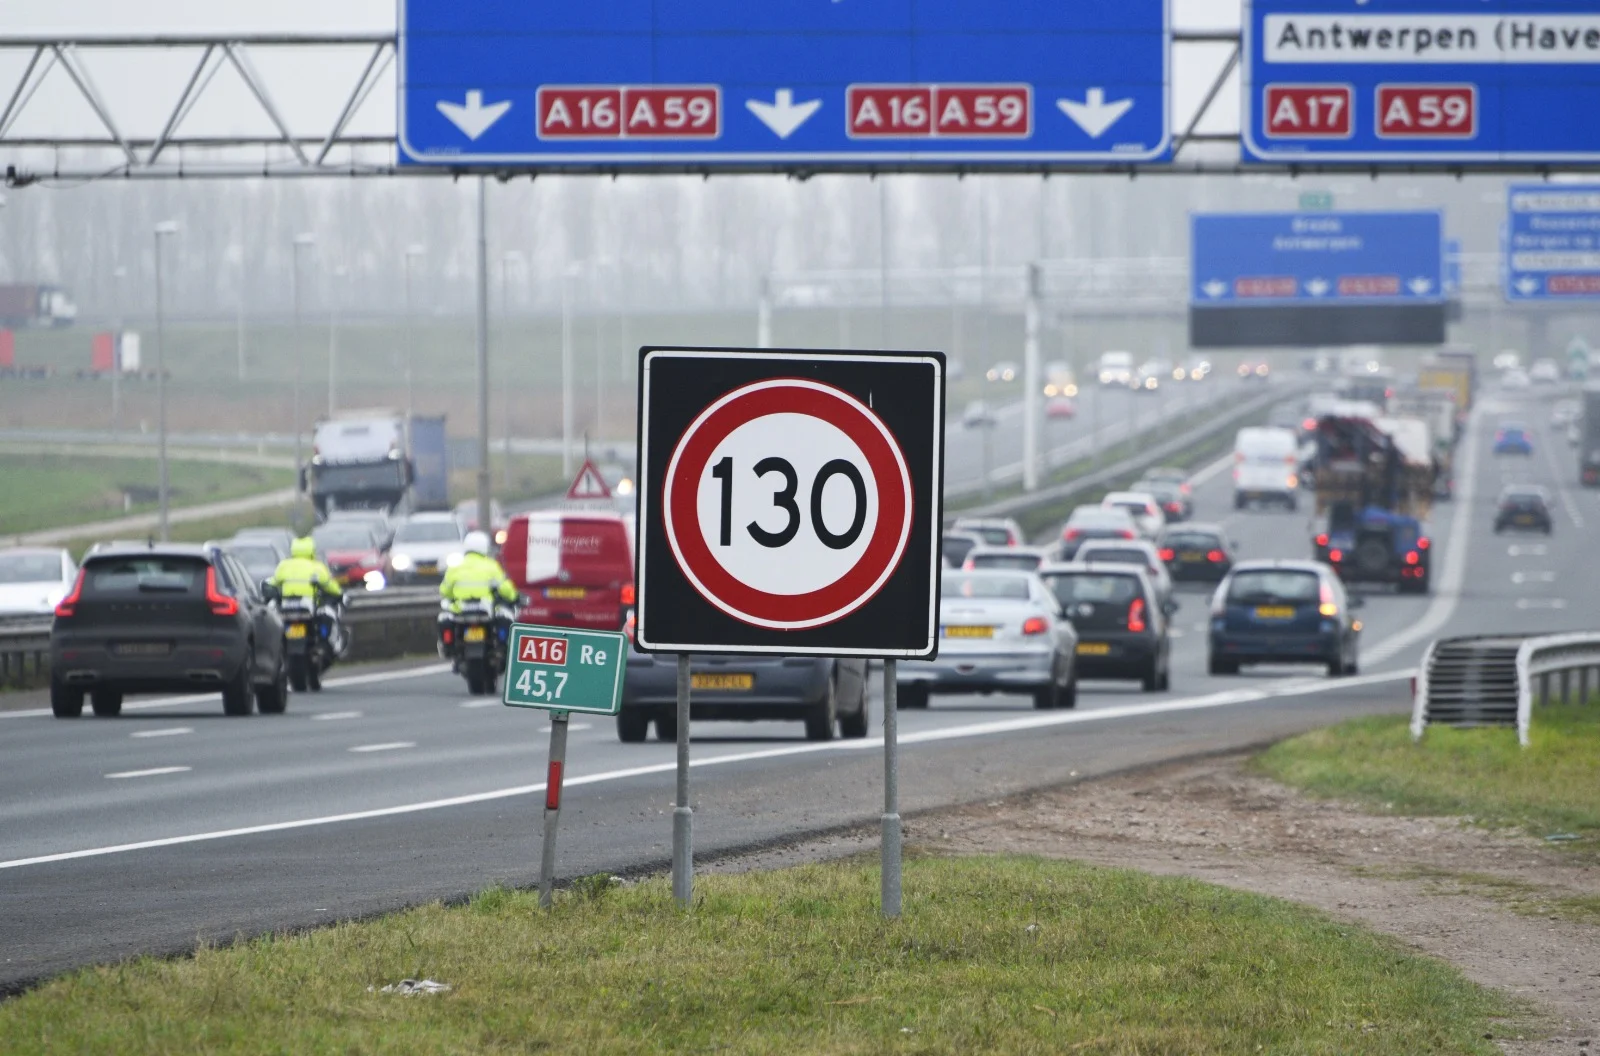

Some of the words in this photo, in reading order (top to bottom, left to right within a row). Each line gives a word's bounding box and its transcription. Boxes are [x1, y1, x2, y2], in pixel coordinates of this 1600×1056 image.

[1278, 22, 1477, 55] Antwerpen
[712, 456, 867, 550] 130
[522, 640, 563, 661] A16
[580, 645, 607, 666] Re
[515, 669, 568, 702] 45,7
